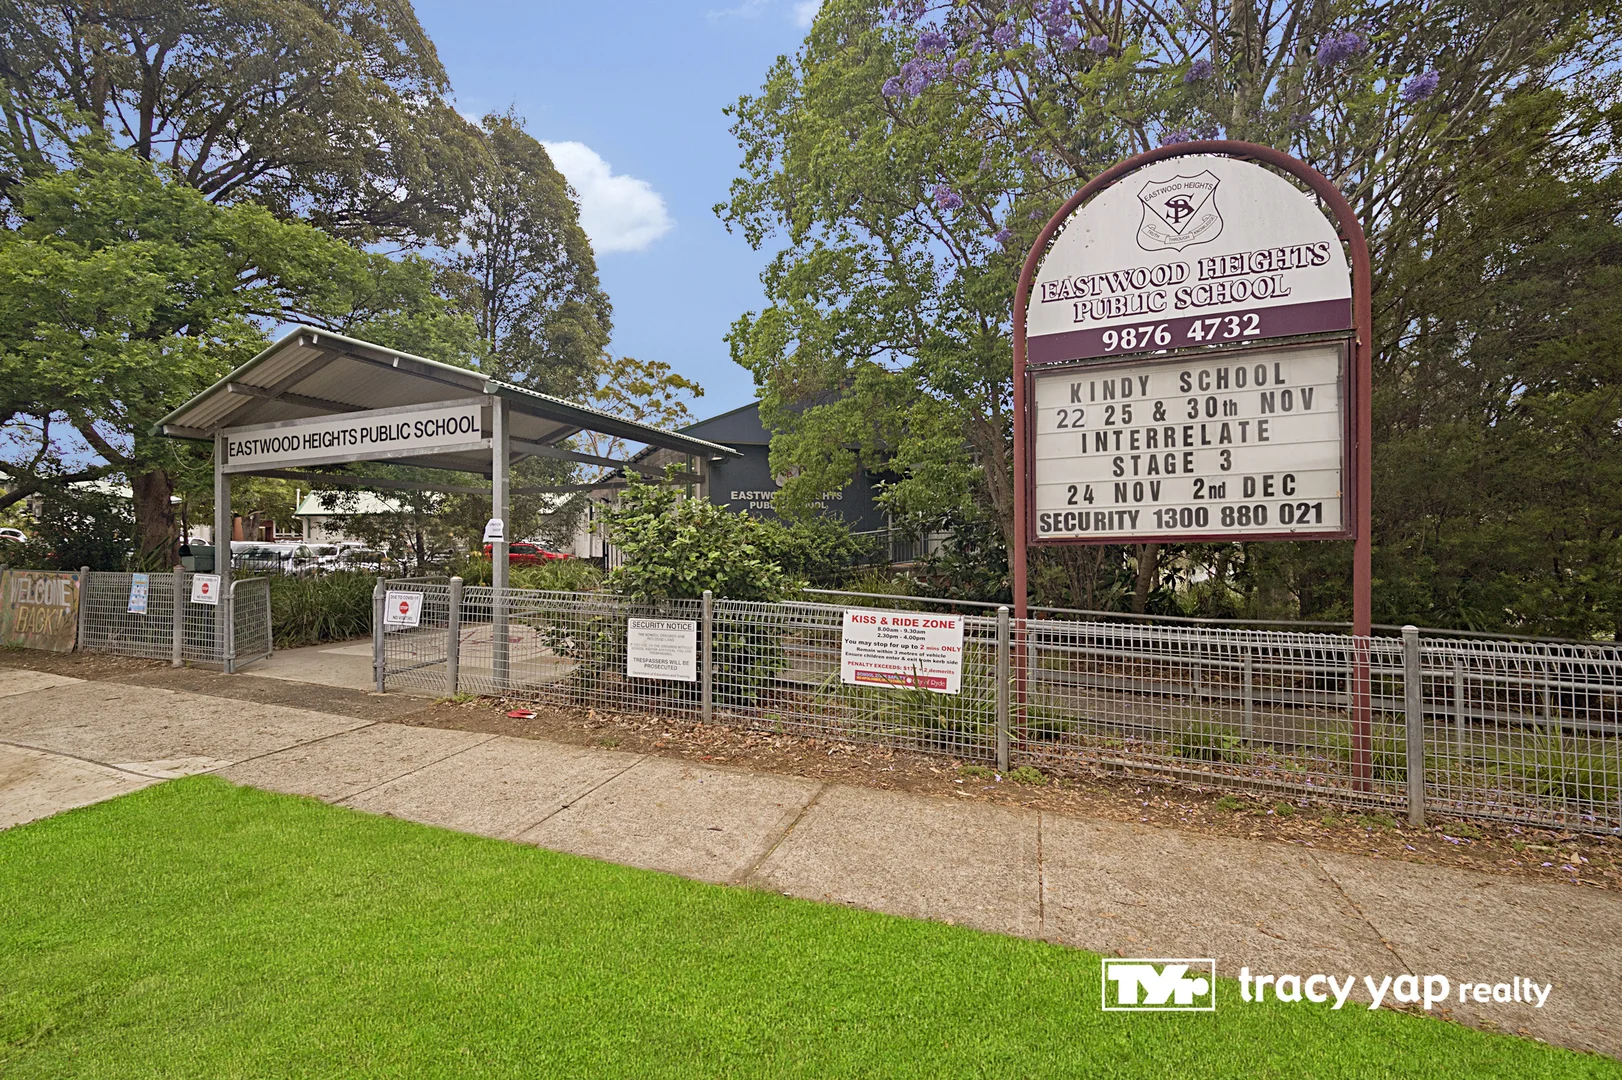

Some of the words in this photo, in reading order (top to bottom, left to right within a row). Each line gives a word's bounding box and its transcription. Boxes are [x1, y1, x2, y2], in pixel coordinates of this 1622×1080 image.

[1144, 183, 1182, 202] EASTWOOD
[1184, 182, 1214, 190] HEIGHTS
[1041, 262, 1190, 303] EASTWOOD
[1198, 242, 1331, 280] HEIGHTS
[1073, 290, 1168, 323] PUBLIC
[1175, 274, 1292, 310] SCHOOL
[1102, 324, 1171, 352] 9876
[1187, 314, 1260, 342] 4732
[1070, 375, 1150, 404] KINDY
[1180, 362, 1286, 393] SCHOOL
[1056, 408, 1085, 429] 22
[1104, 404, 1132, 426] 25
[1152, 400, 1166, 422] &
[1187, 396, 1238, 420] 30th
[1260, 388, 1314, 414] NOV
[229, 435, 300, 457] EASTWOOD
[303, 428, 358, 450] HEIGHTS
[360, 422, 410, 444] PUBLIC
[414, 415, 480, 438] SCHOOL
[1082, 419, 1270, 454] INTERRELATE
[1113, 452, 1194, 478] STAGE
[1220, 449, 1232, 471] 3
[1067, 484, 1094, 505] 24
[1114, 480, 1161, 503] NOV
[1193, 478, 1226, 500] 2nd
[1243, 474, 1296, 498] DEC
[1040, 510, 1140, 532] SECURITY
[1152, 506, 1209, 528] 1300
[1221, 504, 1268, 527] 880
[1279, 502, 1322, 524] 021
[10, 577, 70, 606] WELCOME
[852, 615, 877, 624] KISS
[880, 617, 888, 625] &
[892, 618, 919, 627] RIDE
[922, 620, 955, 629] ZONE
